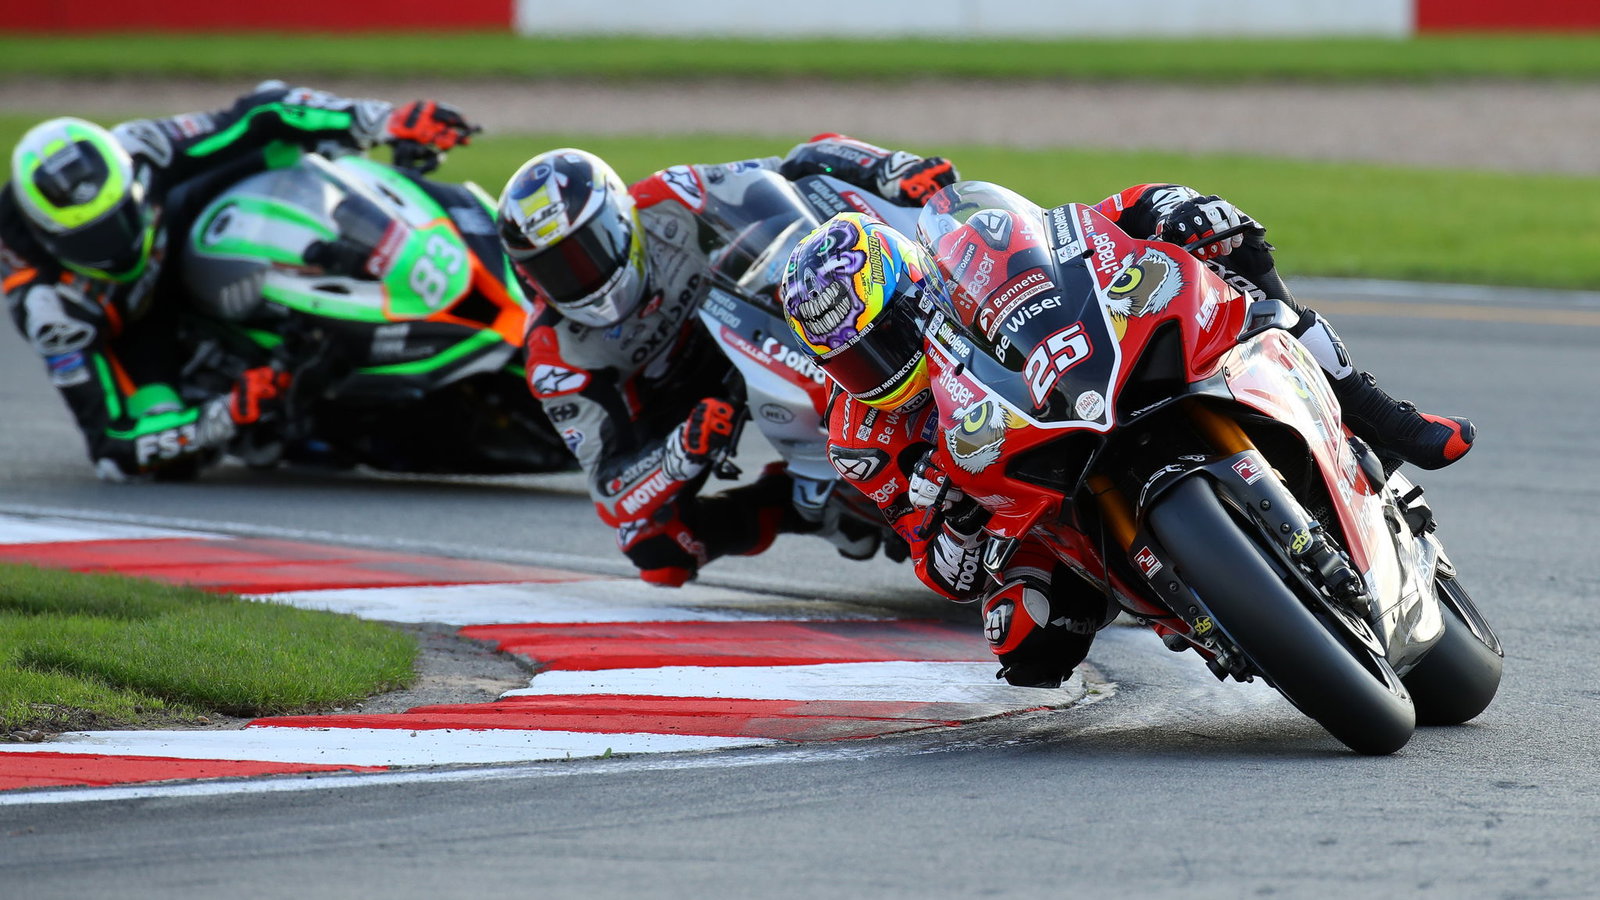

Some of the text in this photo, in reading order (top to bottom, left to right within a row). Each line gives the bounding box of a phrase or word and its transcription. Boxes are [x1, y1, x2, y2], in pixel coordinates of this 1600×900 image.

[1053, 207, 1072, 245] Silkolene
[409, 233, 464, 308] 83
[993, 273, 1045, 309] Bennetts
[702, 299, 742, 329] RAPIDO
[995, 295, 1062, 363] Be Wiser
[939, 323, 970, 358] Silkolene
[882, 350, 923, 389] MOTORCYCLES
[1024, 322, 1092, 407] 25
[878, 426, 894, 445] Be
